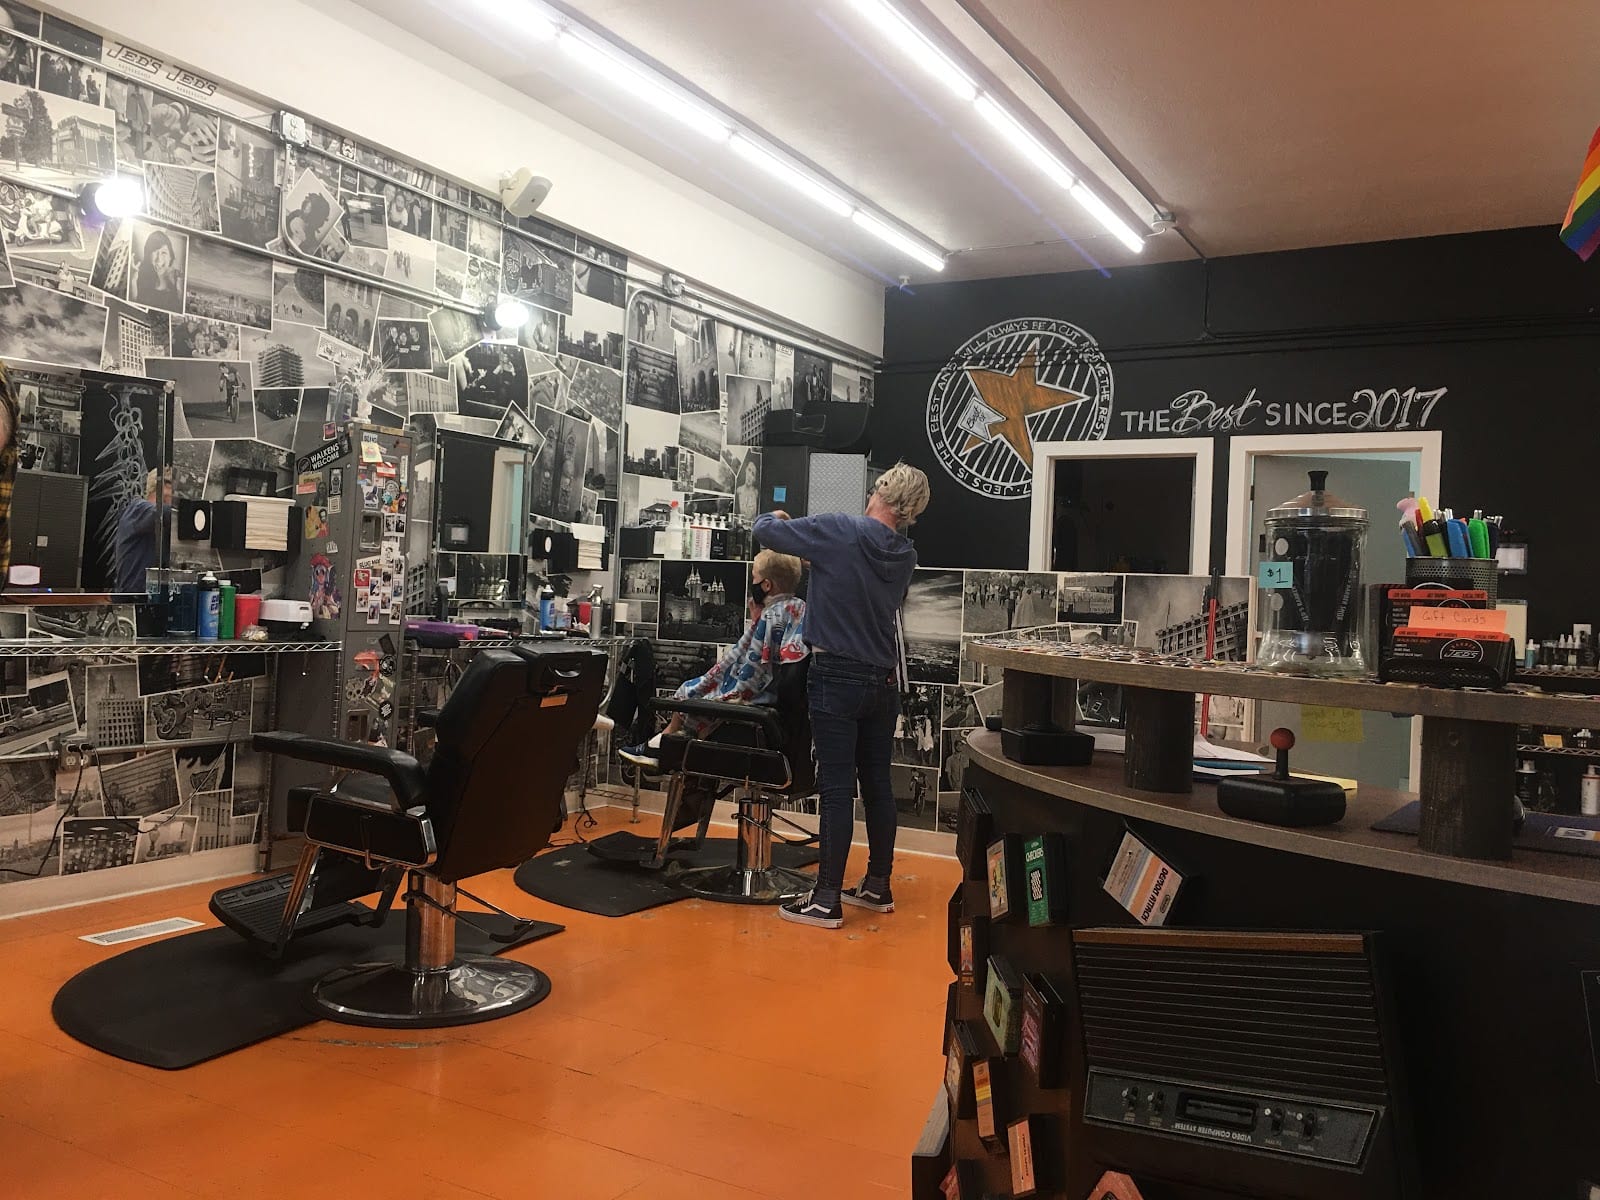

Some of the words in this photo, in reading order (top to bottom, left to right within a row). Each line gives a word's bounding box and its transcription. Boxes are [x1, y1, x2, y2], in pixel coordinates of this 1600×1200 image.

[107, 41, 164, 75] JED'S
[165, 65, 219, 96] JED'S
[986, 321, 1029, 342] ALWAYS
[1032, 321, 1047, 331] BE
[1048, 322, 1058, 332] A
[1058, 325, 1081, 342] CUT
[959, 339, 986, 360] WILL
[1099, 377, 1111, 403] THE
[930, 395, 941, 433] BEST
[1120, 409, 1170, 433] THE
[1169, 388, 1262, 434] Best
[1265, 402, 1347, 427] SINCE
[1348, 386, 1448, 430] 2017
[1092, 406, 1109, 437] REST
[310, 442, 340, 464] WALKENS
[311, 451, 340, 471] WELCOME
[935, 440, 955, 470] THE
[957, 468, 969, 481] IS
[1267, 567, 1289, 584] $1
[1453, 610, 1487, 625] Cards
[1153, 867, 1169, 898] DEMON
[1174, 1122, 1198, 1133] SYSTEM
[1199, 1125, 1230, 1139] COMPUTER
[1231, 1132, 1252, 1143] VIDEO
